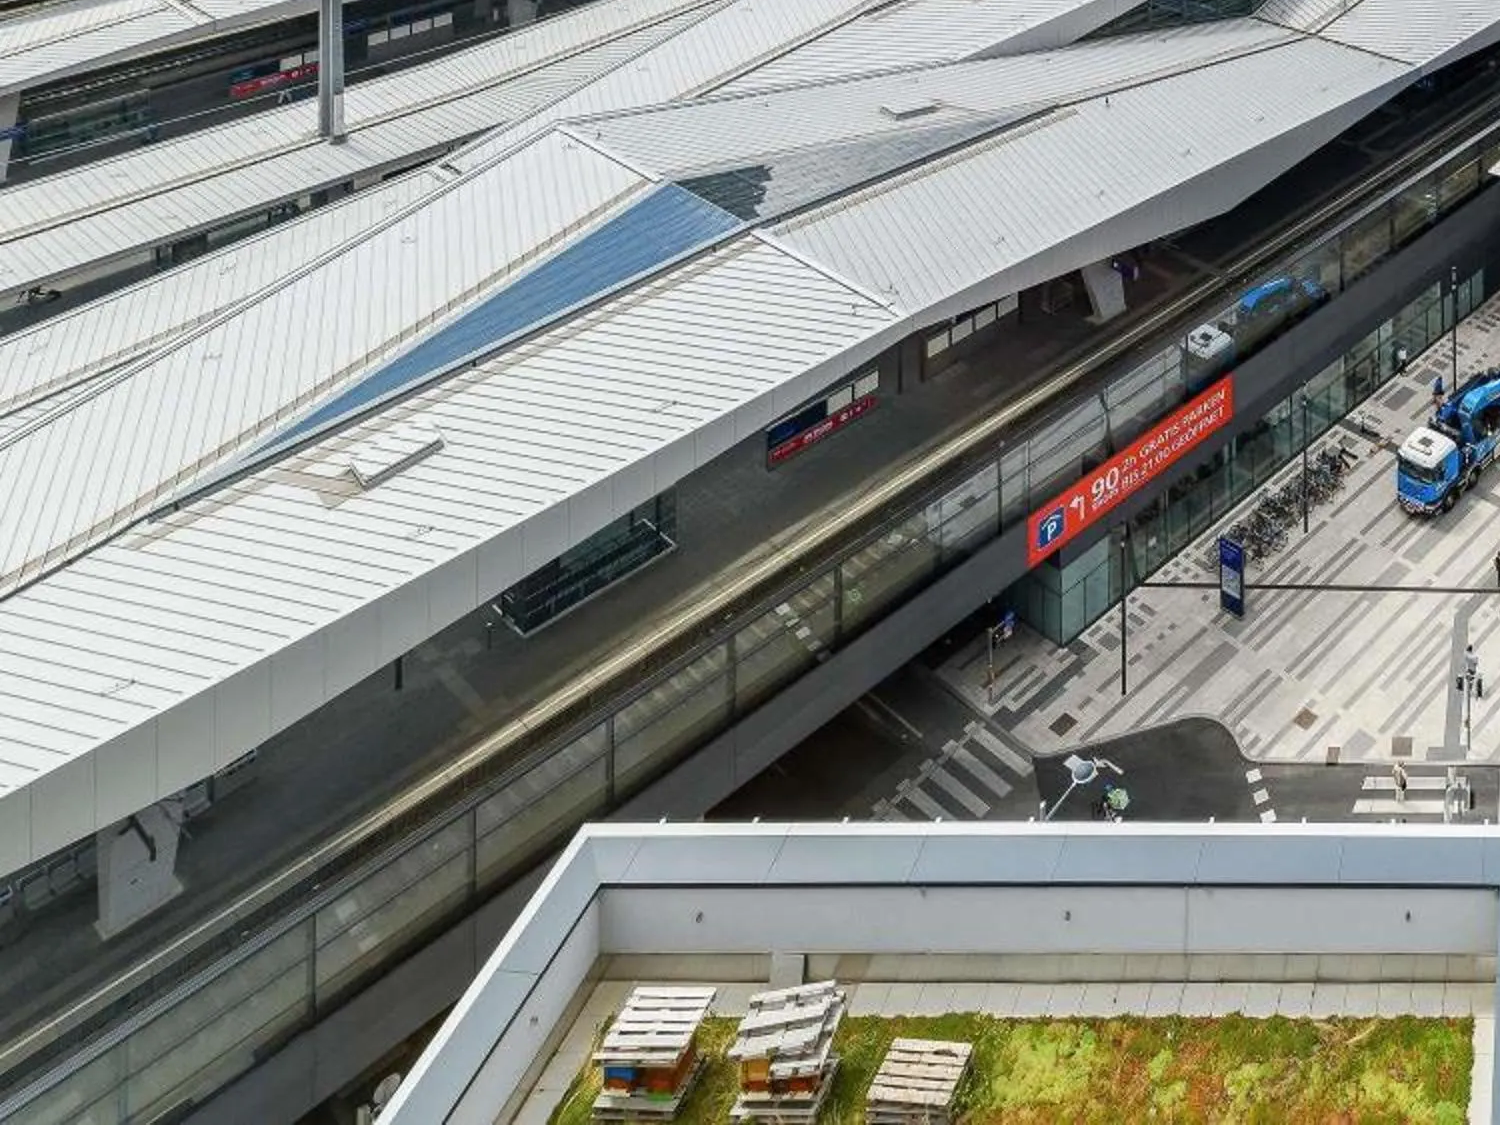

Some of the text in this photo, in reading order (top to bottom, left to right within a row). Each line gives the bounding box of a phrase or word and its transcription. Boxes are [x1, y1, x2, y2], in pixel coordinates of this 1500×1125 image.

[1139, 422, 1180, 458] GRATIS
[1182, 388, 1225, 426] PARKEN
[1091, 466, 1119, 497] 90
